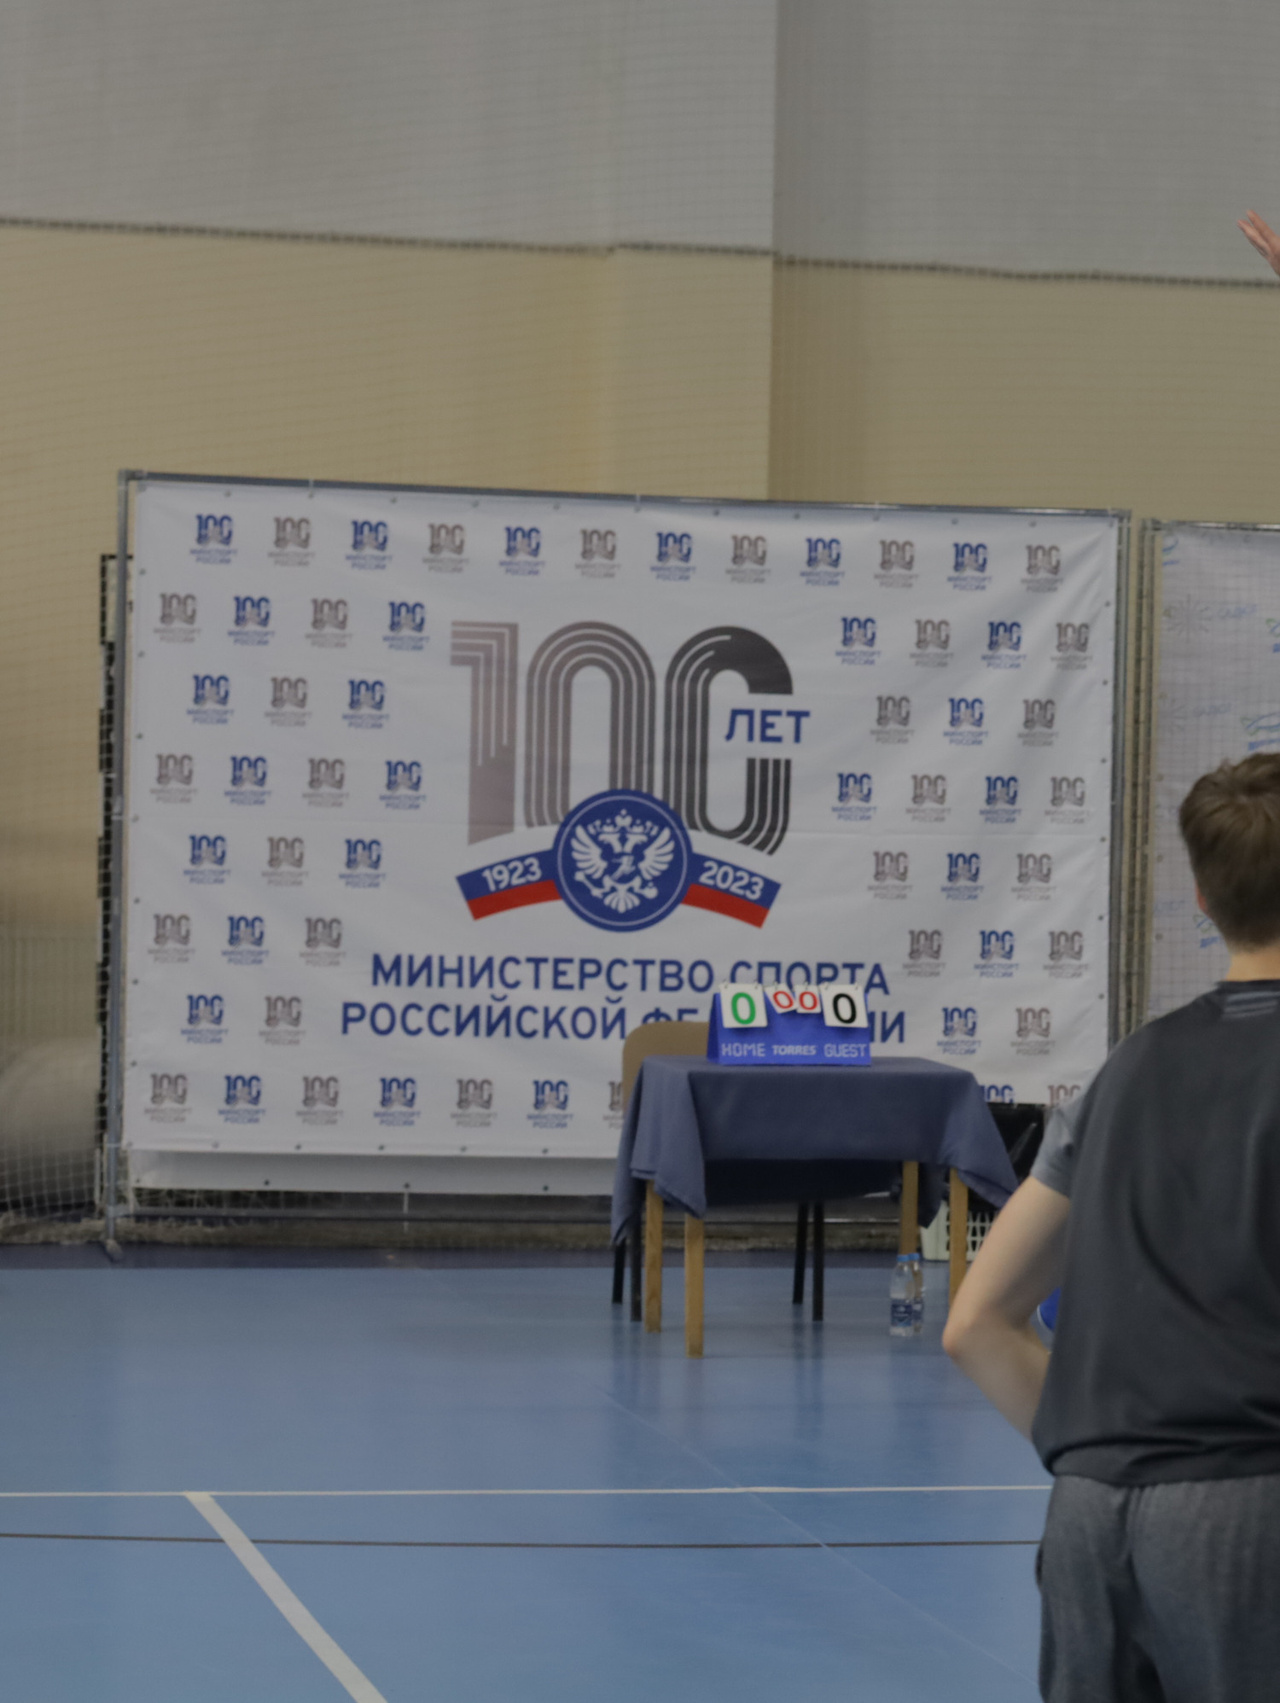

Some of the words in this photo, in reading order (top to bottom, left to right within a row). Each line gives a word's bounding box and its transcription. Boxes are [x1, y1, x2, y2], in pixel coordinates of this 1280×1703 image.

[450, 620, 794, 855] 100
[725, 708, 810, 744] ЛЕТ
[482, 857, 542, 892] 1923
[699, 860, 764, 901] 2023
[371, 953, 715, 993] МИНИСТЕРСТВО
[730, 961, 890, 995] СПОРТА
[341, 993, 627, 1040] РОССИЙСКОЙ
[731, 991, 756, 1025] 0
[832, 993, 857, 1024] 0
[722, 1042, 766, 1057] HOME
[772, 1044, 817, 1056] TORRES
[824, 1043, 868, 1058] GUEST
